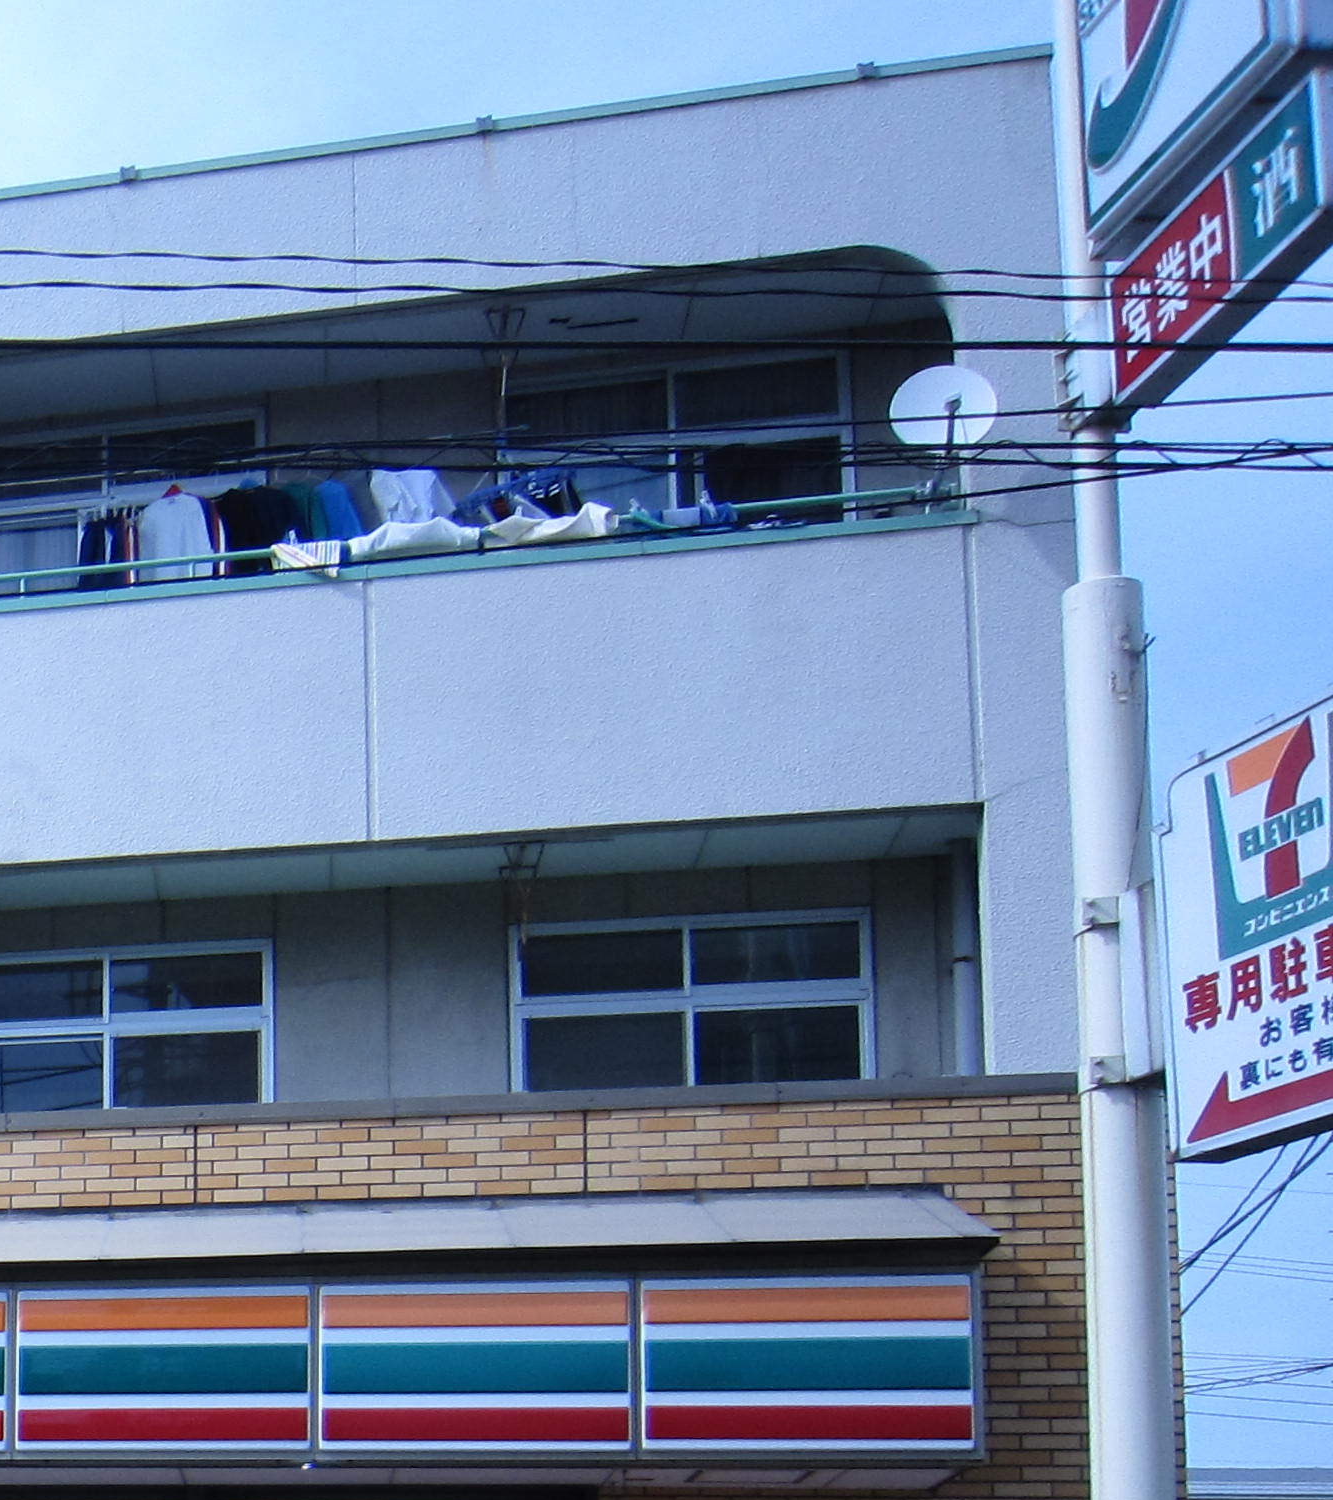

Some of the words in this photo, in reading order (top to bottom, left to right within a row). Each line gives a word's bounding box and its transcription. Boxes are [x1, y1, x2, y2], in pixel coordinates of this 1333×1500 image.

[1251, 126, 1300, 238] 酒
[1121, 213, 1224, 364] 営業中
[1238, 796, 1325, 863] ELEVEN
